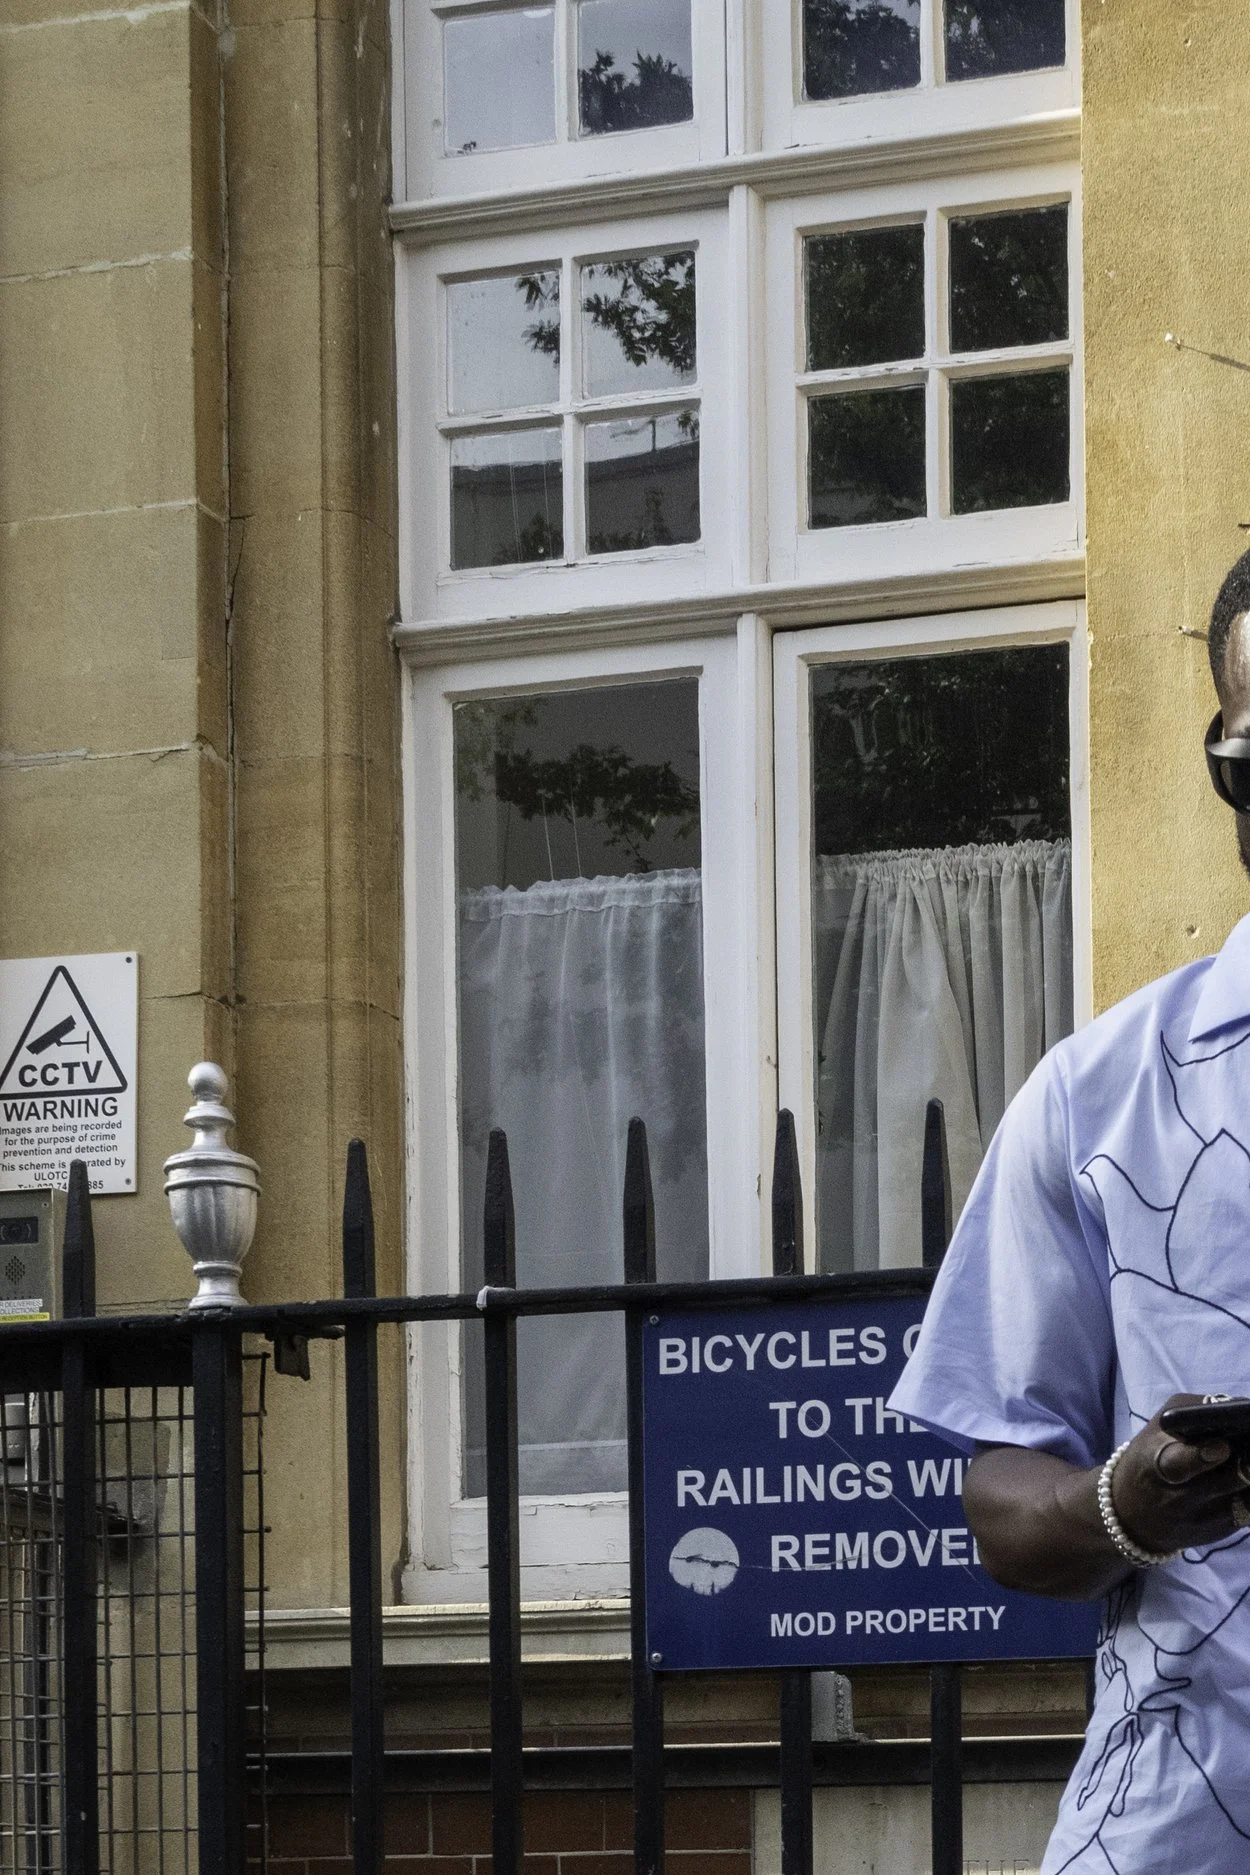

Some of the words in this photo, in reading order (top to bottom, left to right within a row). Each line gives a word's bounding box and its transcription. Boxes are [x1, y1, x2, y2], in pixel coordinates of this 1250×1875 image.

[18, 1060, 103, 1088] CCTV
[3, 1096, 118, 1122] WARNING
[4, 1137, 18, 1146] for
[20, 1136, 35, 1146] the
[37, 1135, 76, 1146] purpose
[78, 1133, 88, 1142] of
[90, 1132, 116, 1142] crime
[34, 1125, 49, 1134] are
[52, 1122, 78, 1134] being
[80, 1120, 122, 1131] recorded
[3, 1147, 52, 1159] prevention
[55, 1145, 72, 1155] and
[75, 1143, 118, 1154] detection
[18, 1161, 56, 1171] scheme
[58, 1159, 67, 1169] is
[114, 1156, 126, 1168] by
[34, 1170, 68, 1181] ULOTC
[658, 1325, 887, 1375] BICYCLES
[769, 1399, 832, 1439] TO
[845, 1396, 929, 1436] TH
[676, 1460, 893, 1507] RAILINGS
[770, 1611, 837, 1637] MOD
[845, 1605, 1006, 1634] PROPERTY
